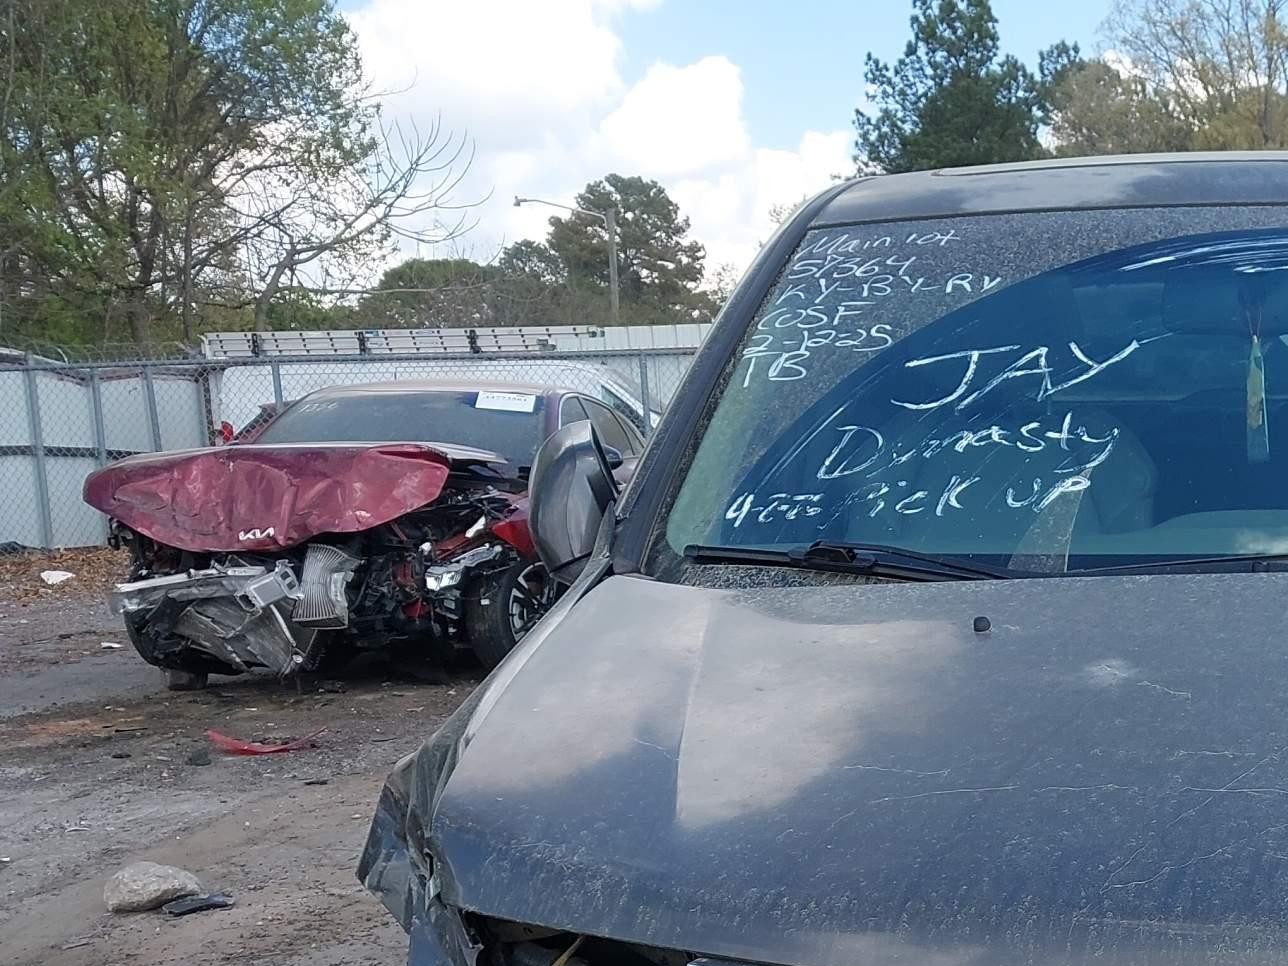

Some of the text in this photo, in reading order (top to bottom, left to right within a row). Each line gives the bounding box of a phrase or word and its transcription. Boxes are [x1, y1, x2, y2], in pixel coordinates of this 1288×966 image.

[796, 233, 892, 260] Main
[741, 349, 811, 388] TB
[889, 339, 1141, 416] JAY
[238, 526, 275, 541] KIA
